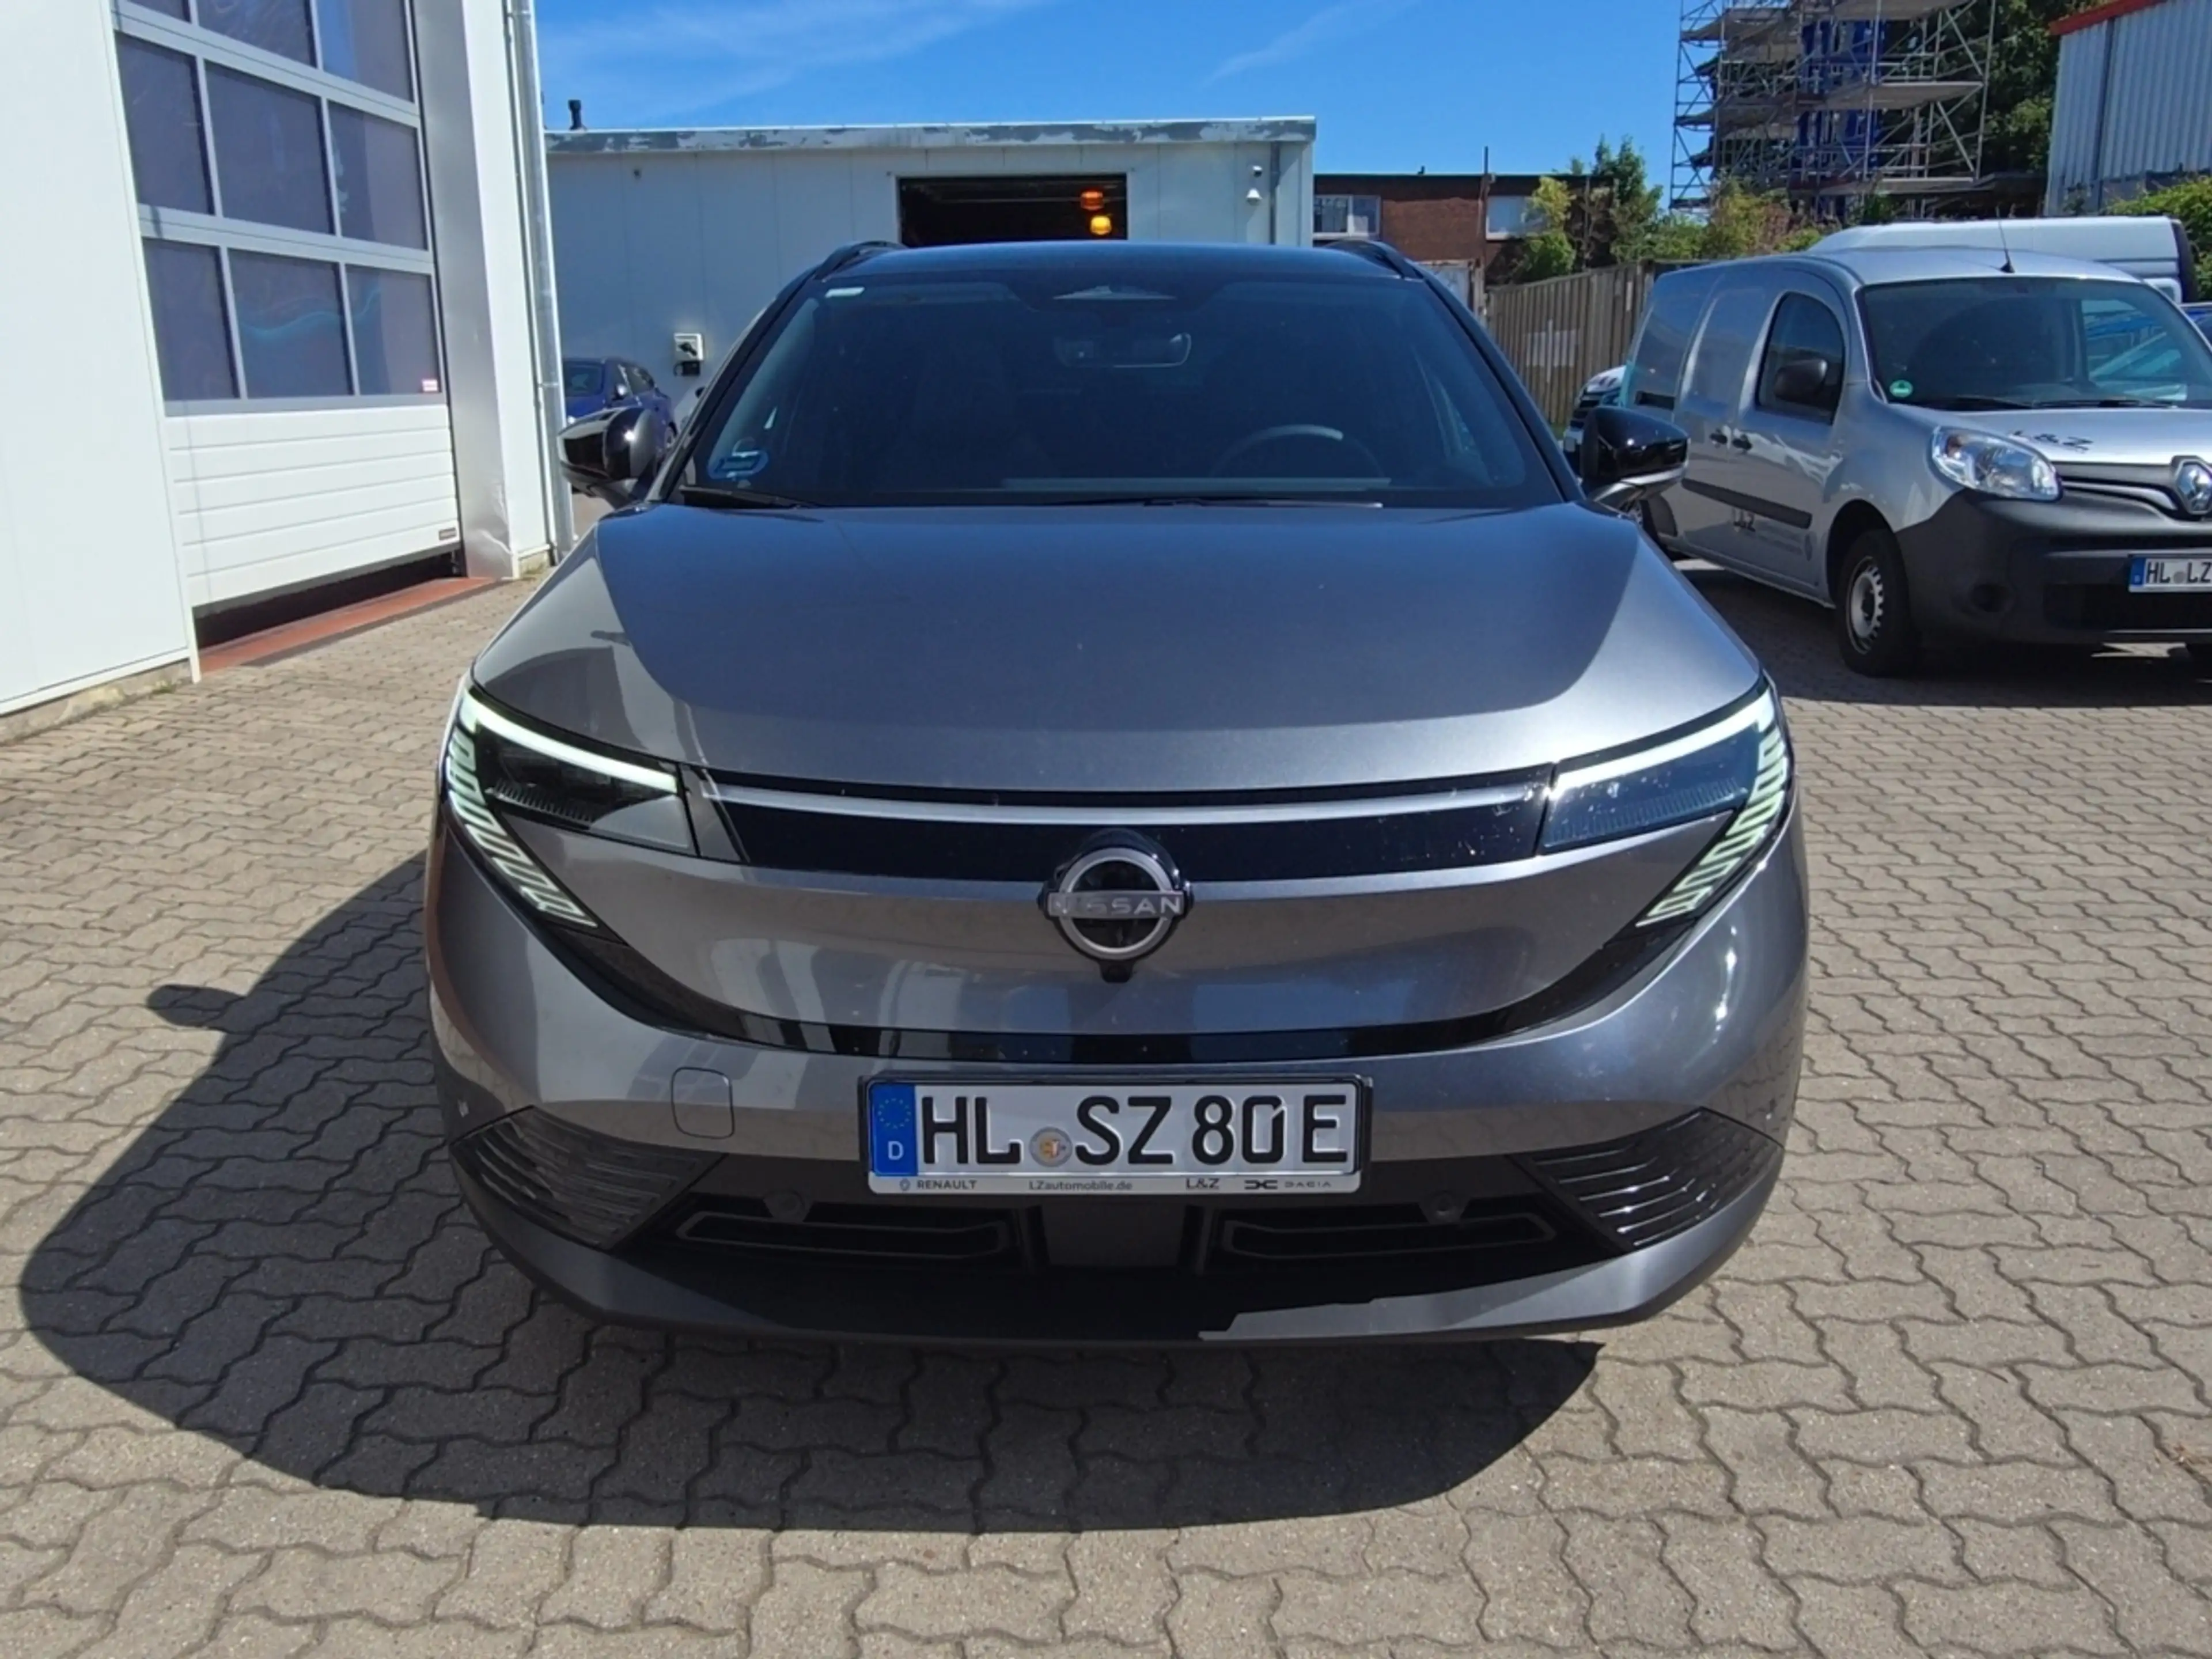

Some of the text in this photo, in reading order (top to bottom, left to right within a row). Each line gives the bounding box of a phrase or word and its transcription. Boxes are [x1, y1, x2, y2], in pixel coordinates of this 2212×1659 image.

[2146, 562, 2171, 584] HL
[2187, 562, 2212, 584] LZ
[1054, 897, 1181, 915] NSSAN
[922, 1096, 1022, 1165] HL
[1074, 1095, 1174, 1165] SZ
[887, 1141, 904, 1160] D
[916, 1180, 978, 1190] RENAULT
[1028, 1180, 1133, 1191] LZautomobile.de
[1185, 1177, 1220, 1190] L&Z
